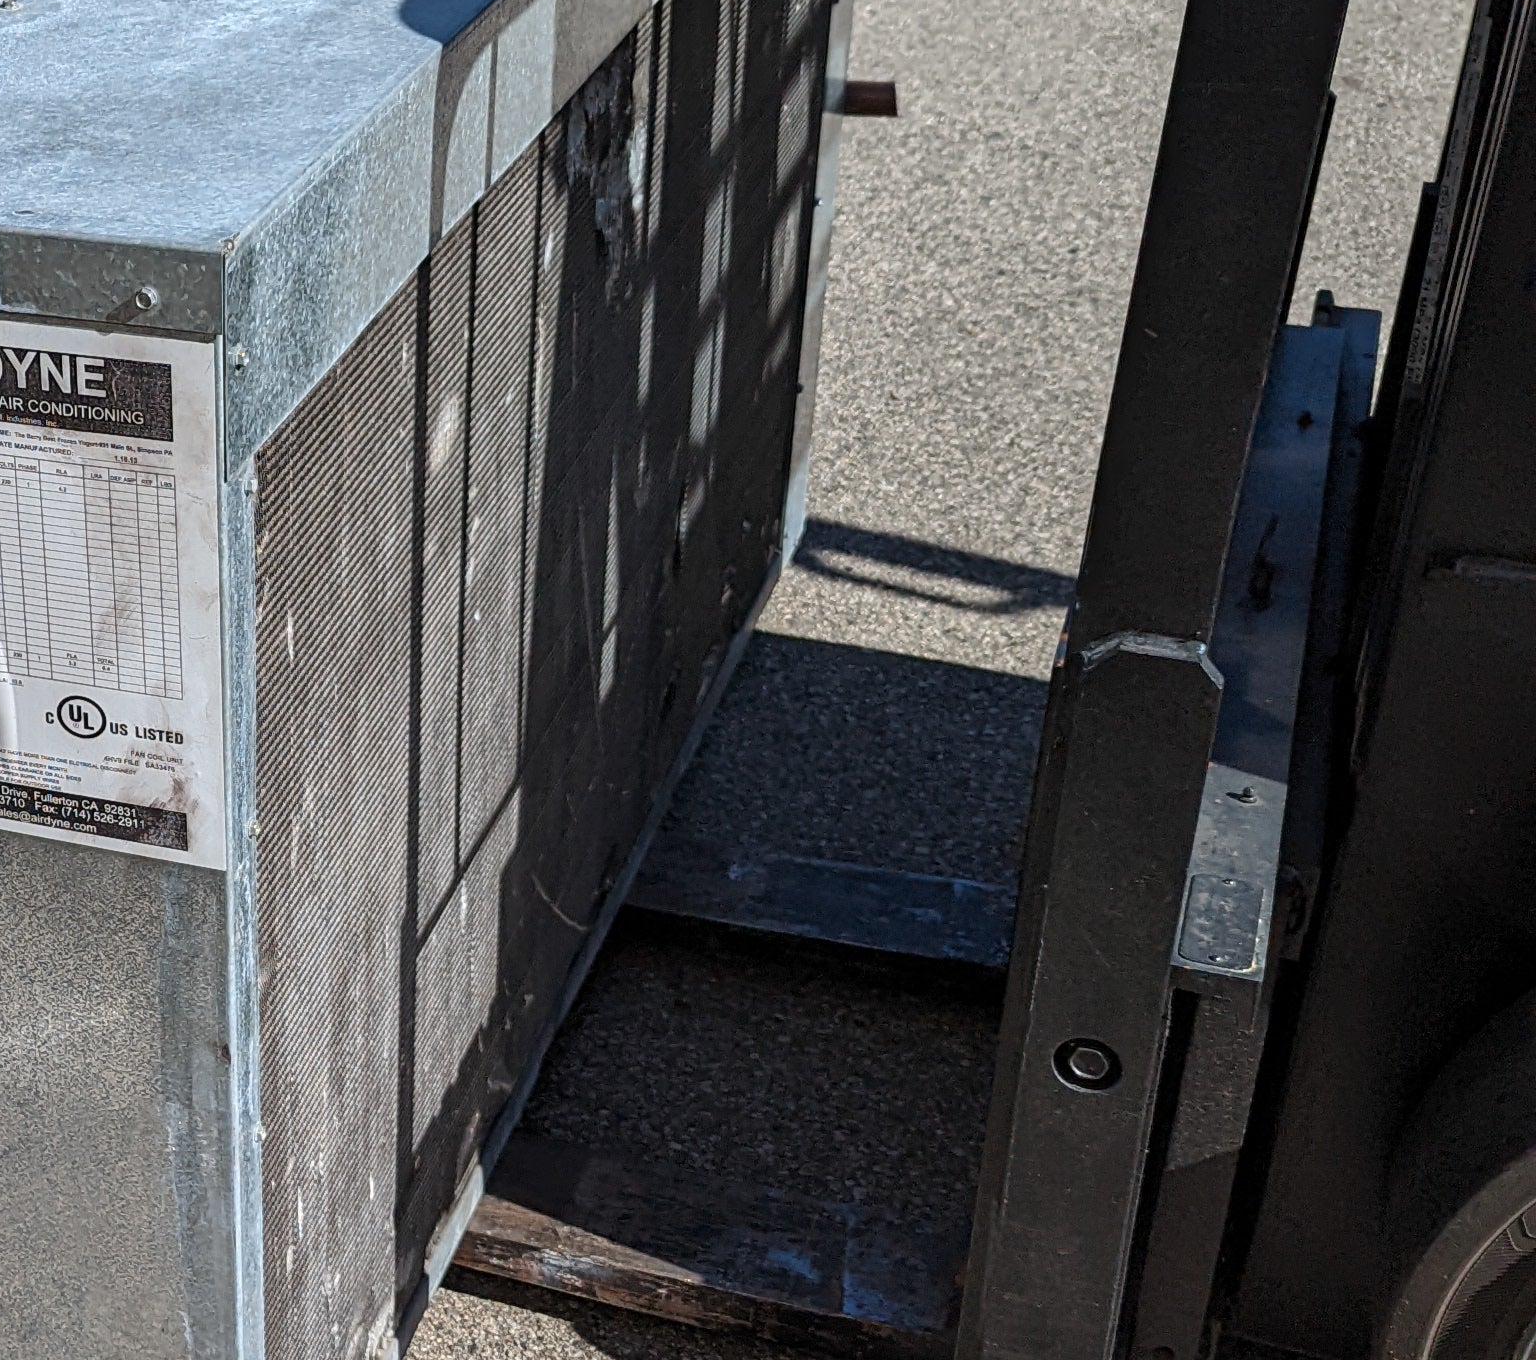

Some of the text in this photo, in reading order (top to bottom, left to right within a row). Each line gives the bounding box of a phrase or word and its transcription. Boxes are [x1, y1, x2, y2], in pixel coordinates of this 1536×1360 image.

[27, 400, 145, 425] CONDITIONING
[14, 442, 74, 456] MANUFACTURED:
[45, 703, 184, 745] C UL US LISTED
[33, 791, 80, 808] Fullerton
[81, 799, 99, 811] CA
[104, 803, 137, 818] 92831
[34, 801, 59, 815] Fax:
[61, 806, 91, 821] (714)
[93, 813, 146, 830] 526-2911
